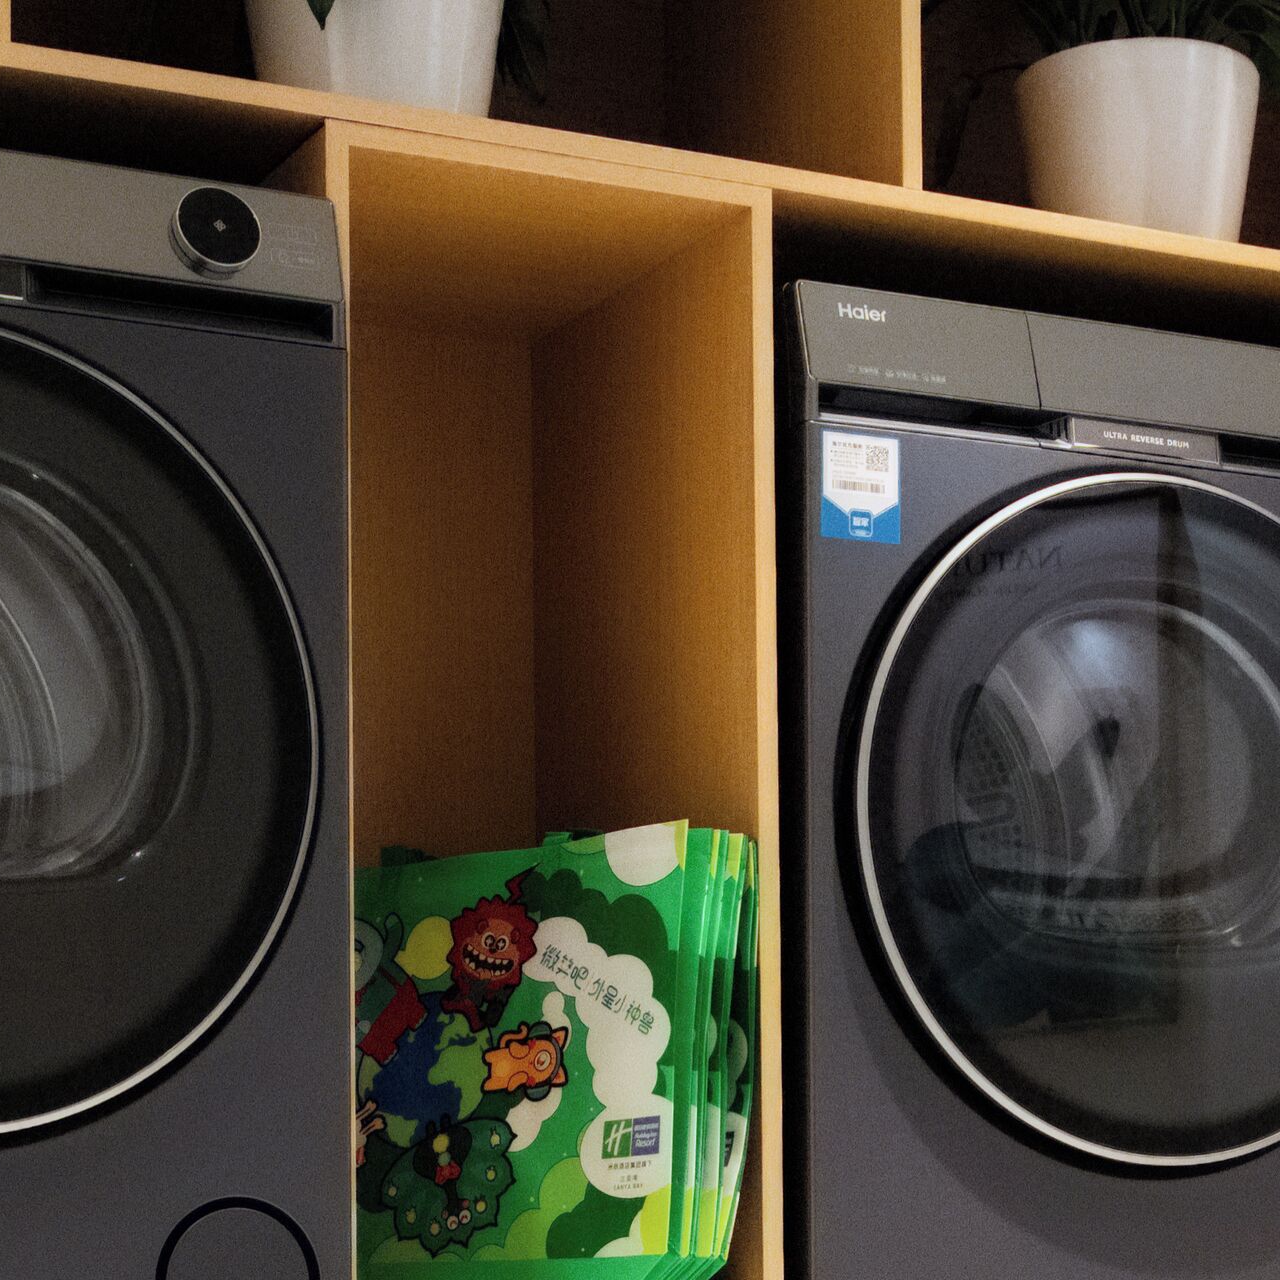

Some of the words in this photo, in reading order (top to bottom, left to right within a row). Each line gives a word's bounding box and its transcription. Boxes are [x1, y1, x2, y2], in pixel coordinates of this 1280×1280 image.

[838, 302, 886, 322] Haier
[1103, 430, 1128, 440] ULTRA
[1131, 434, 1164, 446] REVERSE
[1167, 439, 1189, 449] DRUM
